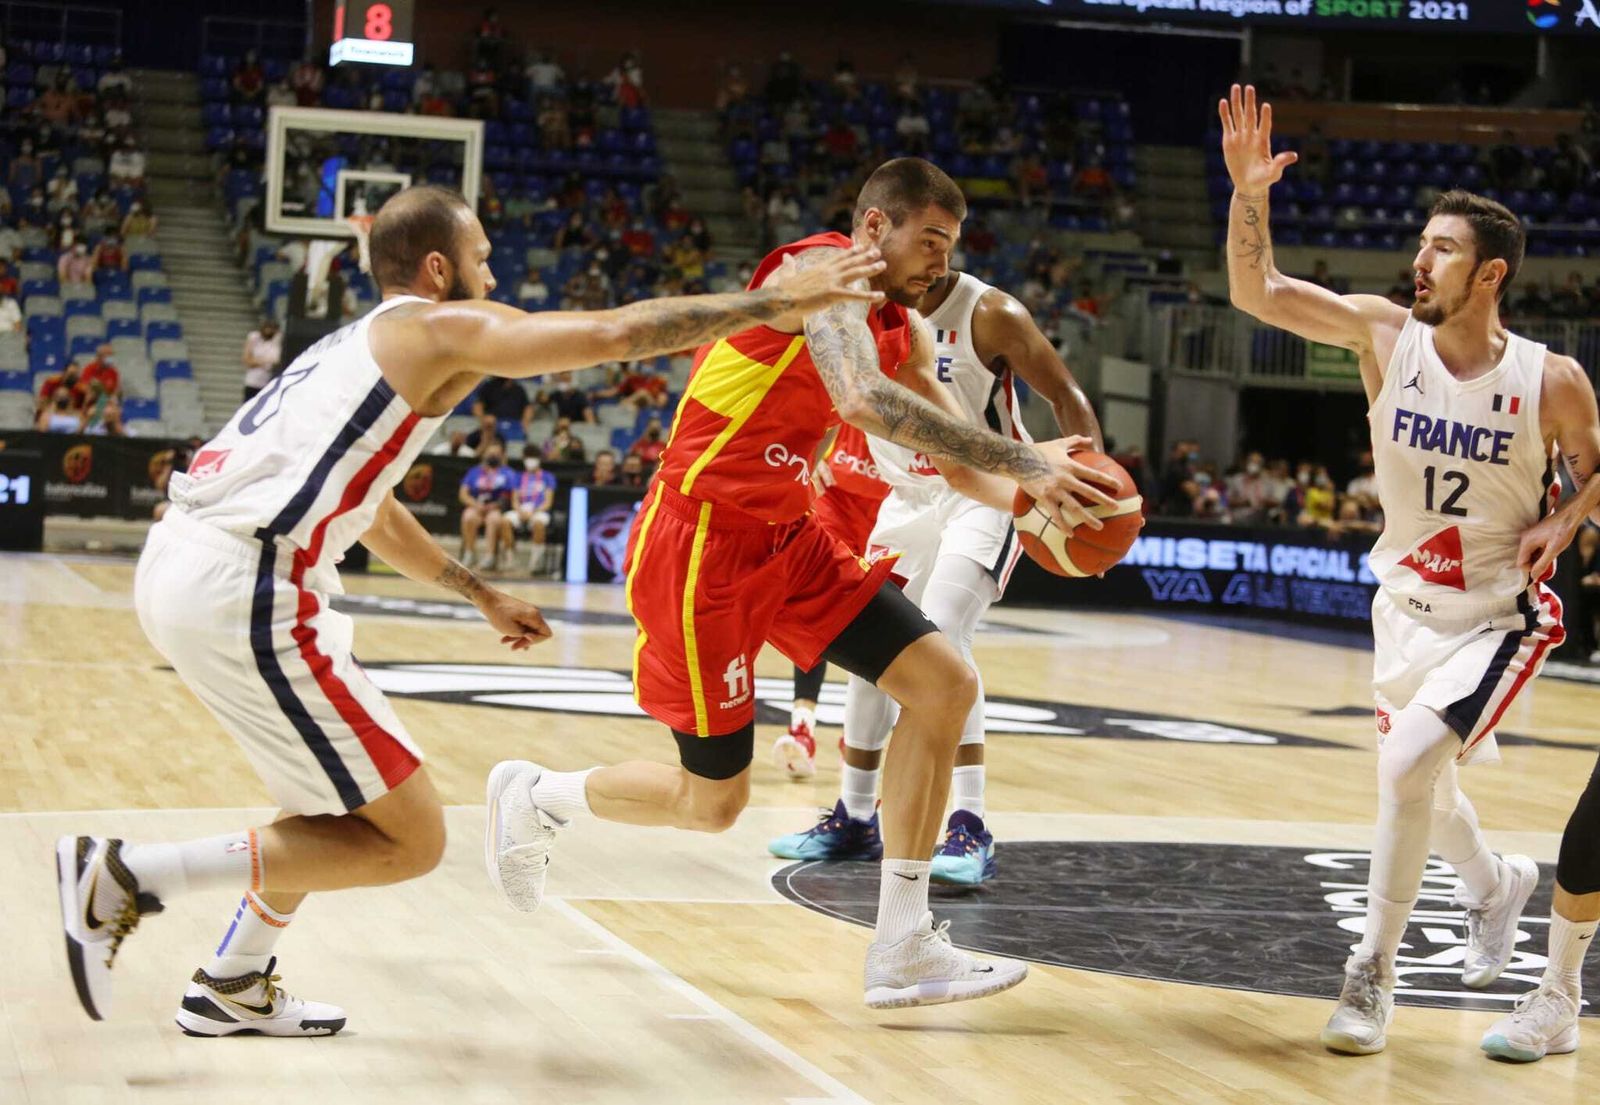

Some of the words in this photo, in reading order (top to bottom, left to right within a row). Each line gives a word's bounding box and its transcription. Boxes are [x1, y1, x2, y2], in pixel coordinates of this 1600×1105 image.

[364, 3, 393, 41] 8
[1285, 0, 1312, 15] of
[1316, 0, 1403, 18] SPORT
[1409, 1, 1468, 20] 2021
[936, 357, 954, 383] E
[1392, 408, 1515, 465] FRANCE
[834, 449, 884, 481] ende
[1424, 465, 1470, 517] 12
[1120, 537, 1268, 573] MISETA
[1142, 569, 1213, 602] YA
[1409, 598, 1432, 613] FRA
